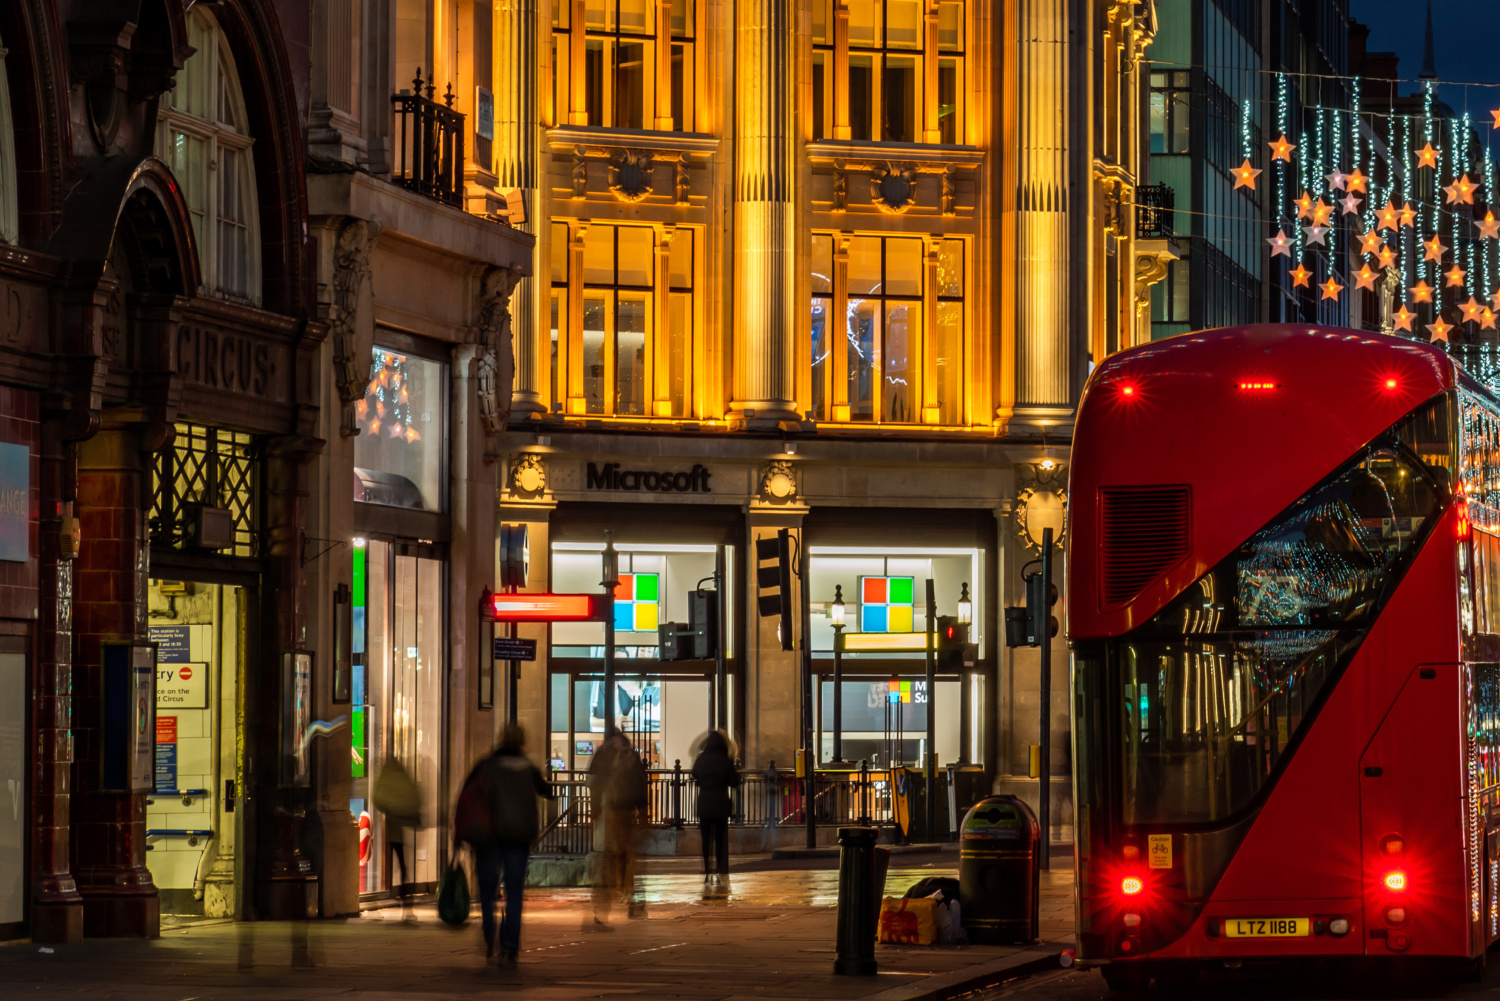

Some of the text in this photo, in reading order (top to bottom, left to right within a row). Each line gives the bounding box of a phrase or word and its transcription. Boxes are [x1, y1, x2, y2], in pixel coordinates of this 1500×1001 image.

[177, 325, 268, 395] CIRCUS
[587, 462, 712, 493] Microsoft
[1237, 920, 1297, 935] LTZ 1188
